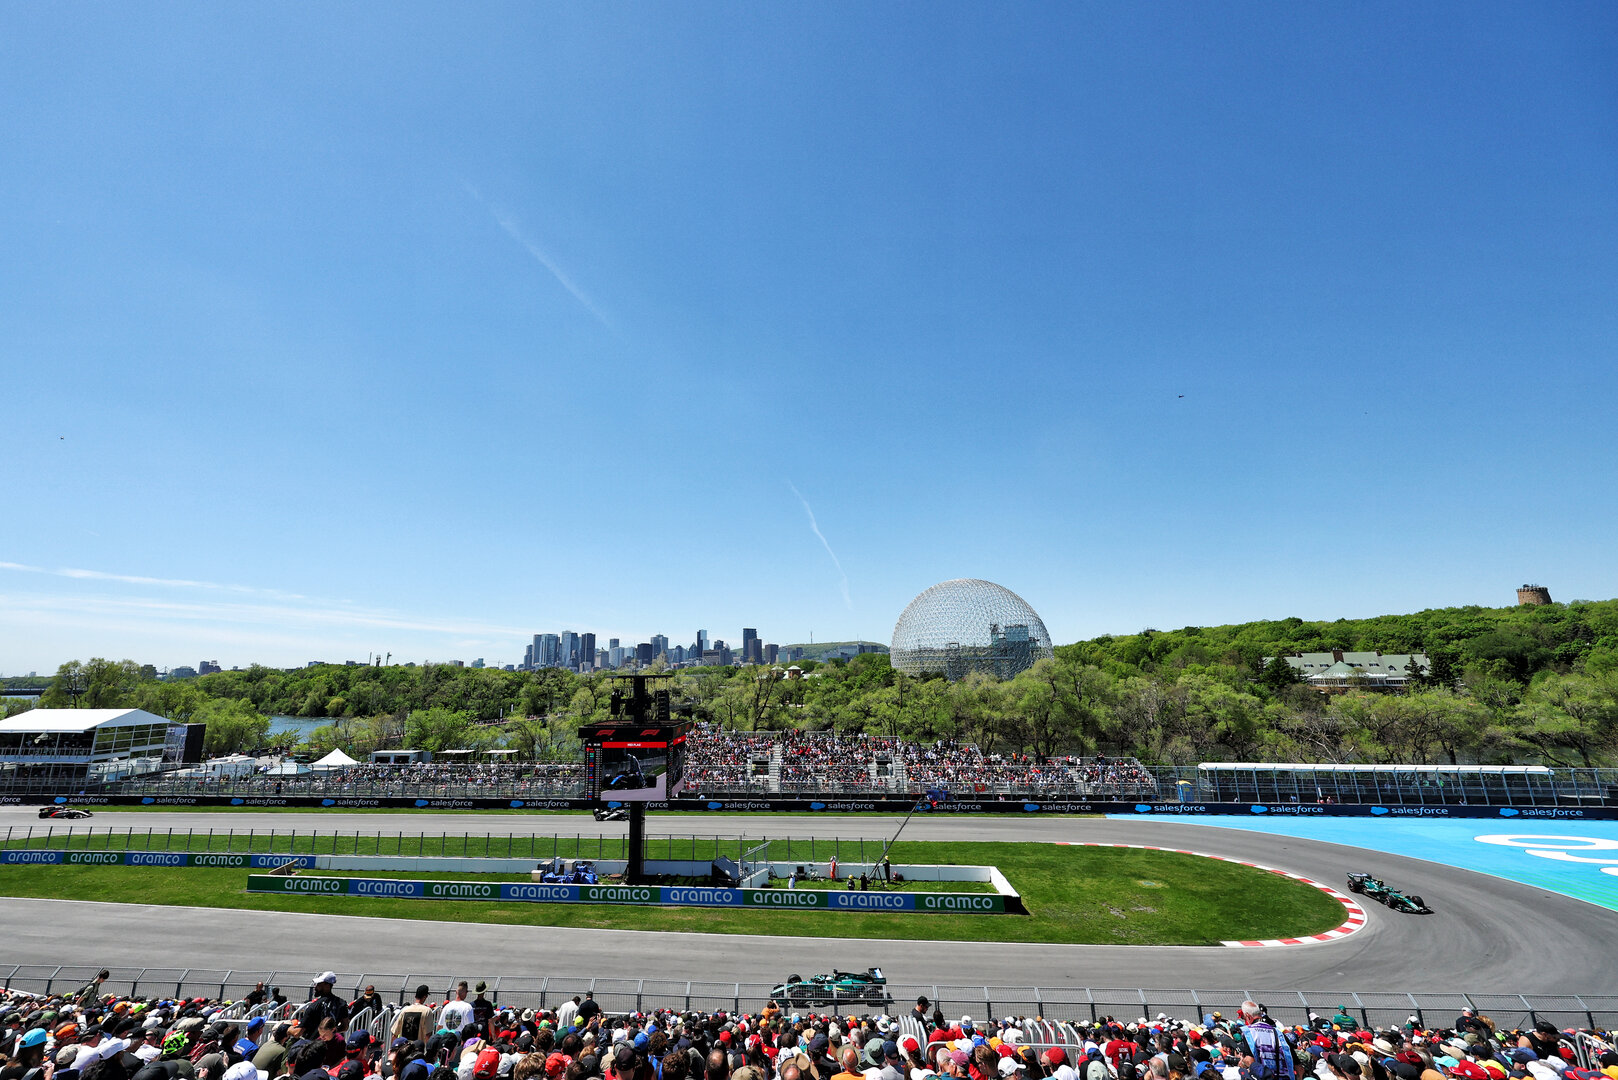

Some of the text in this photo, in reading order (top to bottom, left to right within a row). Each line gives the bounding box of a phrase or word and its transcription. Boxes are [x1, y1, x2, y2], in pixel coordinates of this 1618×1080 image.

[68, 796, 108, 805] salesforce
[156, 796, 196, 805] salesforce
[245, 797, 287, 806] salesforce
[337, 798, 379, 807] salesforce
[430, 798, 473, 808] salesforce
[526, 799, 570, 808] salesforce
[724, 800, 770, 810] salesforce
[827, 801, 875, 810] salesforce
[933, 802, 982, 811] salesforce
[1041, 803, 1092, 812] salesforce
[1154, 804, 1206, 814] salesforce
[1270, 805, 1324, 815] salesforce
[1391, 807, 1449, 816] salesforce
[1522, 808, 1584, 817] salesforce
[8, 852, 55, 862] aramco
[70, 852, 118, 864] aramco
[132, 853, 179, 865] aramco
[194, 854, 242, 866] aramco
[284, 879, 341, 893] aramco
[358, 881, 415, 895] aramco
[432, 884, 492, 897] aramco
[508, 886, 569, 900] aramco
[589, 888, 650, 902] aramco
[670, 890, 733, 903] aramco
[753, 891, 817, 906] aramco
[838, 892, 904, 907] aramco
[925, 894, 993, 910] aramco
